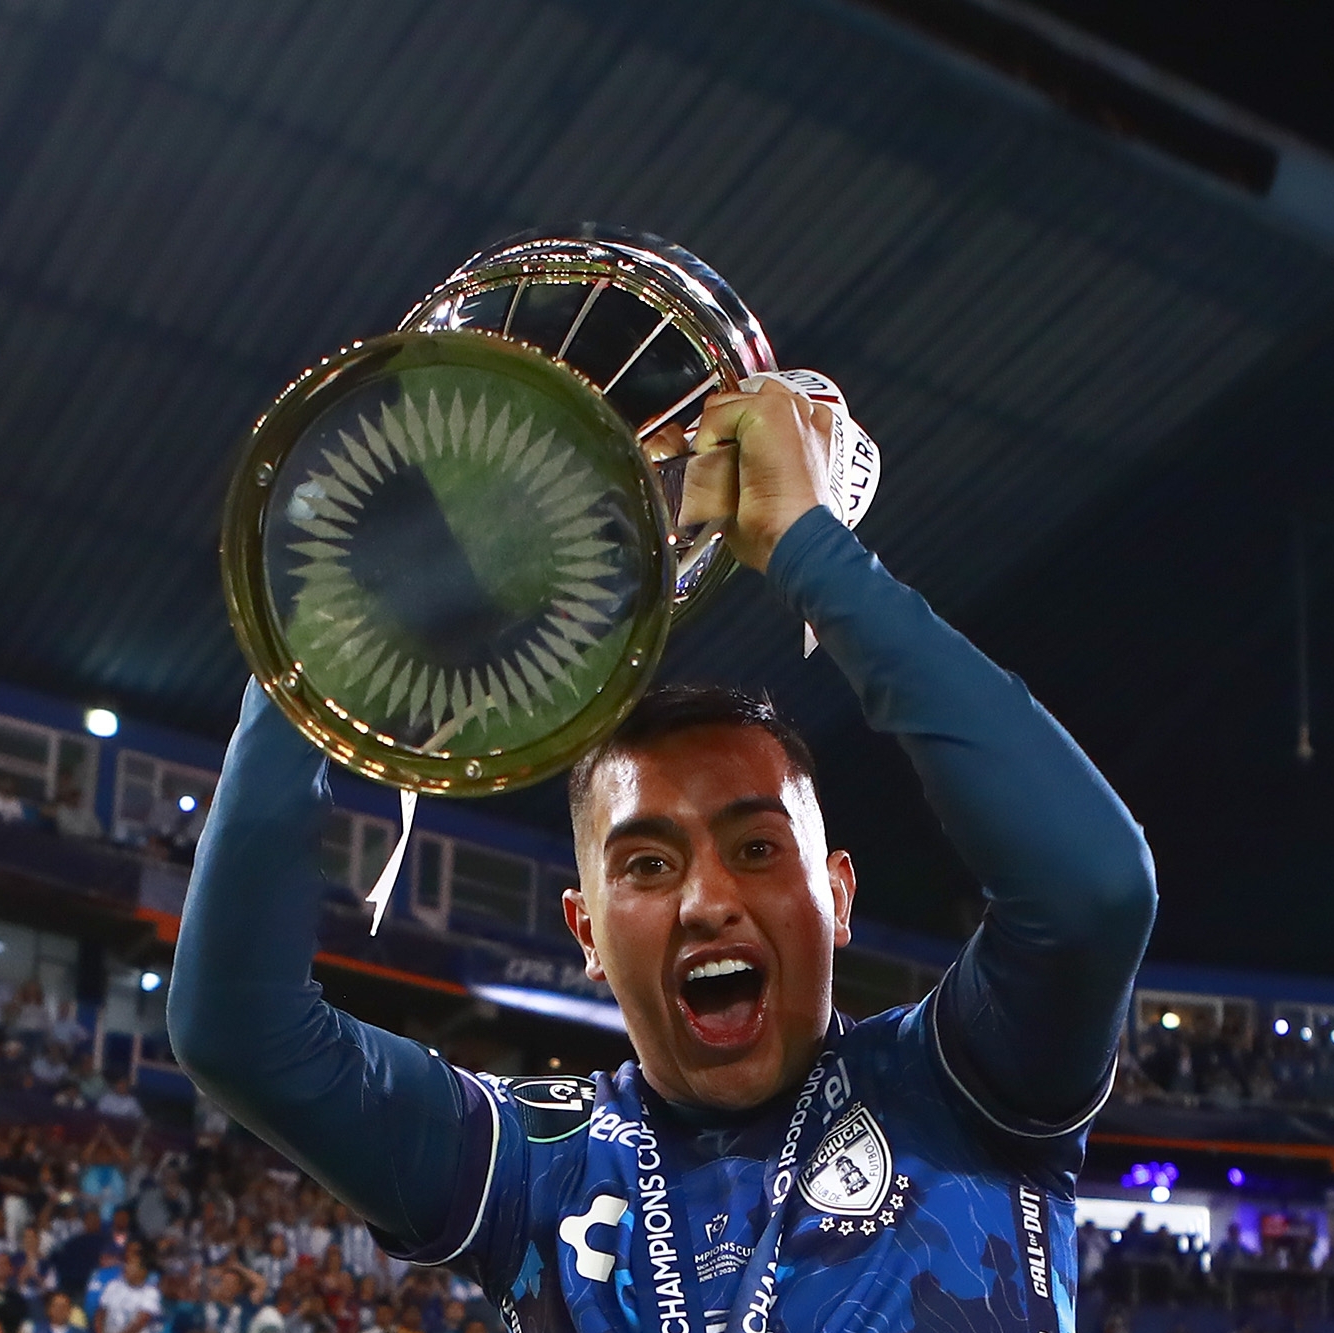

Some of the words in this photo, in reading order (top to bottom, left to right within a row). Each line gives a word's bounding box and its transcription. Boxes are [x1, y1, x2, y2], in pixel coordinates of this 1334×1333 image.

[804, 1122, 865, 1179] PACHUCA
[864, 1139, 880, 1178] FUTBOL
[828, 1192, 843, 1203] DE
[1029, 1232, 1040, 1246] OF
[1029, 1245, 1049, 1299] CALL
